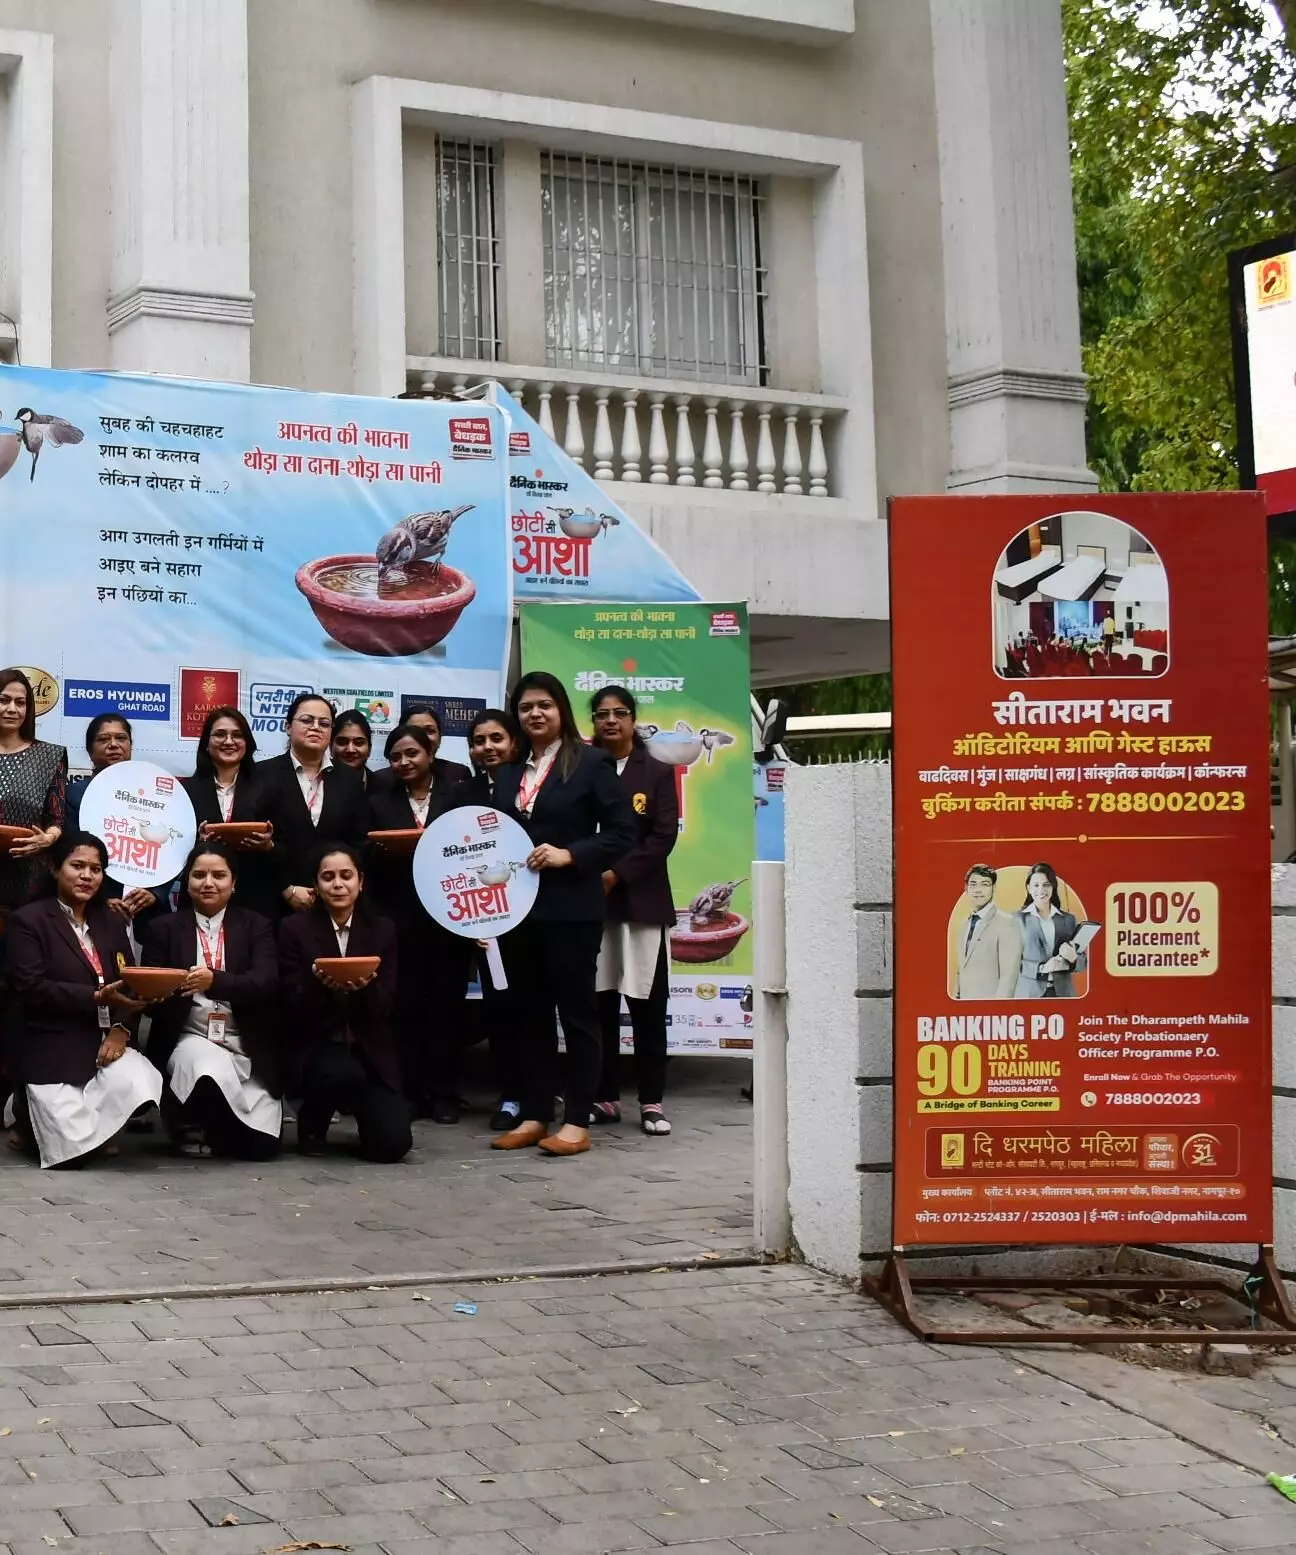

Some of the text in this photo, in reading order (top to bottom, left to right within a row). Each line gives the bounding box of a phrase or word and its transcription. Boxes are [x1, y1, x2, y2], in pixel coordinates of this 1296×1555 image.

[99, 415, 224, 439] सुबह की चहचहाहट
[276, 421, 410, 450] अपनत्व की भावना
[98, 444, 200, 465] शाम का कलरव
[242, 447, 277, 475] थोड़ा
[282, 454, 302, 473] सा
[385, 463, 404, 481] सा
[409, 460, 442, 484] पानी
[98, 467, 201, 492] लेकिन दोपहर में
[509, 475, 568, 491] दैनिक भास्कर
[511, 509, 556, 534] छोटी सी
[99, 529, 264, 553] आग उगलती इन गर्मियों में
[512, 535, 592, 577] आशा
[98, 556, 202, 578] आइए बने सहारा
[96, 585, 117, 603] इन
[120, 584, 164, 603] पंछियों
[630, 609, 644, 623] की
[598, 629, 609, 639] सा
[660, 629, 672, 639] सा
[675, 626, 696, 639] पानी
[627, 675, 684, 692] भास्कर
[69, 688, 166, 703] EROS HYUNDAI
[118, 702, 165, 712] GHAT ROAD
[992, 691, 1173, 725] सीताराम भवन
[953, 730, 1212, 756] ऑडिटोरियम आणि गेस्ट हाऊस
[918, 765, 969, 784] वाढदिवस
[977, 765, 996, 787] मुंज
[1004, 764, 1048, 783] साक्षगंध
[1083, 763, 1139, 785] सांस्कृतिक
[1140, 762, 1186, 780] कार्यक्रम
[1193, 762, 1247, 779] कॉन्फरन्स
[921, 790, 1245, 819] बुकिंग करीता संपर्क 7888002023
[104, 832, 161, 870] आशा
[440, 873, 467, 892] छोटी
[447, 883, 507, 921] आशा
[1113, 891, 1201, 924] 100%
[1117, 930, 1200, 946] Placement
[917, 1013, 1064, 1042] BANKING P.O
[1078, 1014, 1249, 1027] Join The Dharampeth Mahila
[1078, 1031, 1208, 1044] Society Probationaery
[988, 1044, 1028, 1060] DAYS
[1078, 1047, 1220, 1060] Officer Programme P.O.
[917, 1043, 982, 1096] 90
[988, 1061, 1061, 1077] TRAINING
[1083, 1072, 1237, 1083] Enroll Now Grab The Opportunity
[988, 1078, 1053, 1086] BANKING POINT
[988, 1085, 1041, 1093] PROGRAMME
[934, 1101, 965, 1110] Bridge
[968, 1100, 978, 1108] of
[980, 1100, 1018, 1110] Banking
[1020, 1100, 1053, 1108] Career
[1105, 1092, 1201, 1105] 7888002023
[972, 1130, 1139, 1157] दि धरमपेठ महिला
[1192, 1143, 1212, 1161] 31
[941, 1186, 973, 1196] कार्यालय
[1041, 1185, 1072, 1196] सीताराम
[1096, 1187, 1110, 1195] राम
[1111, 1187, 1127, 1195] नगर
[1151, 1185, 1180, 1195] शिवाजी
[943, 1210, 1247, 1223] 0712-2524337 2520303 info@dpmahila.com
